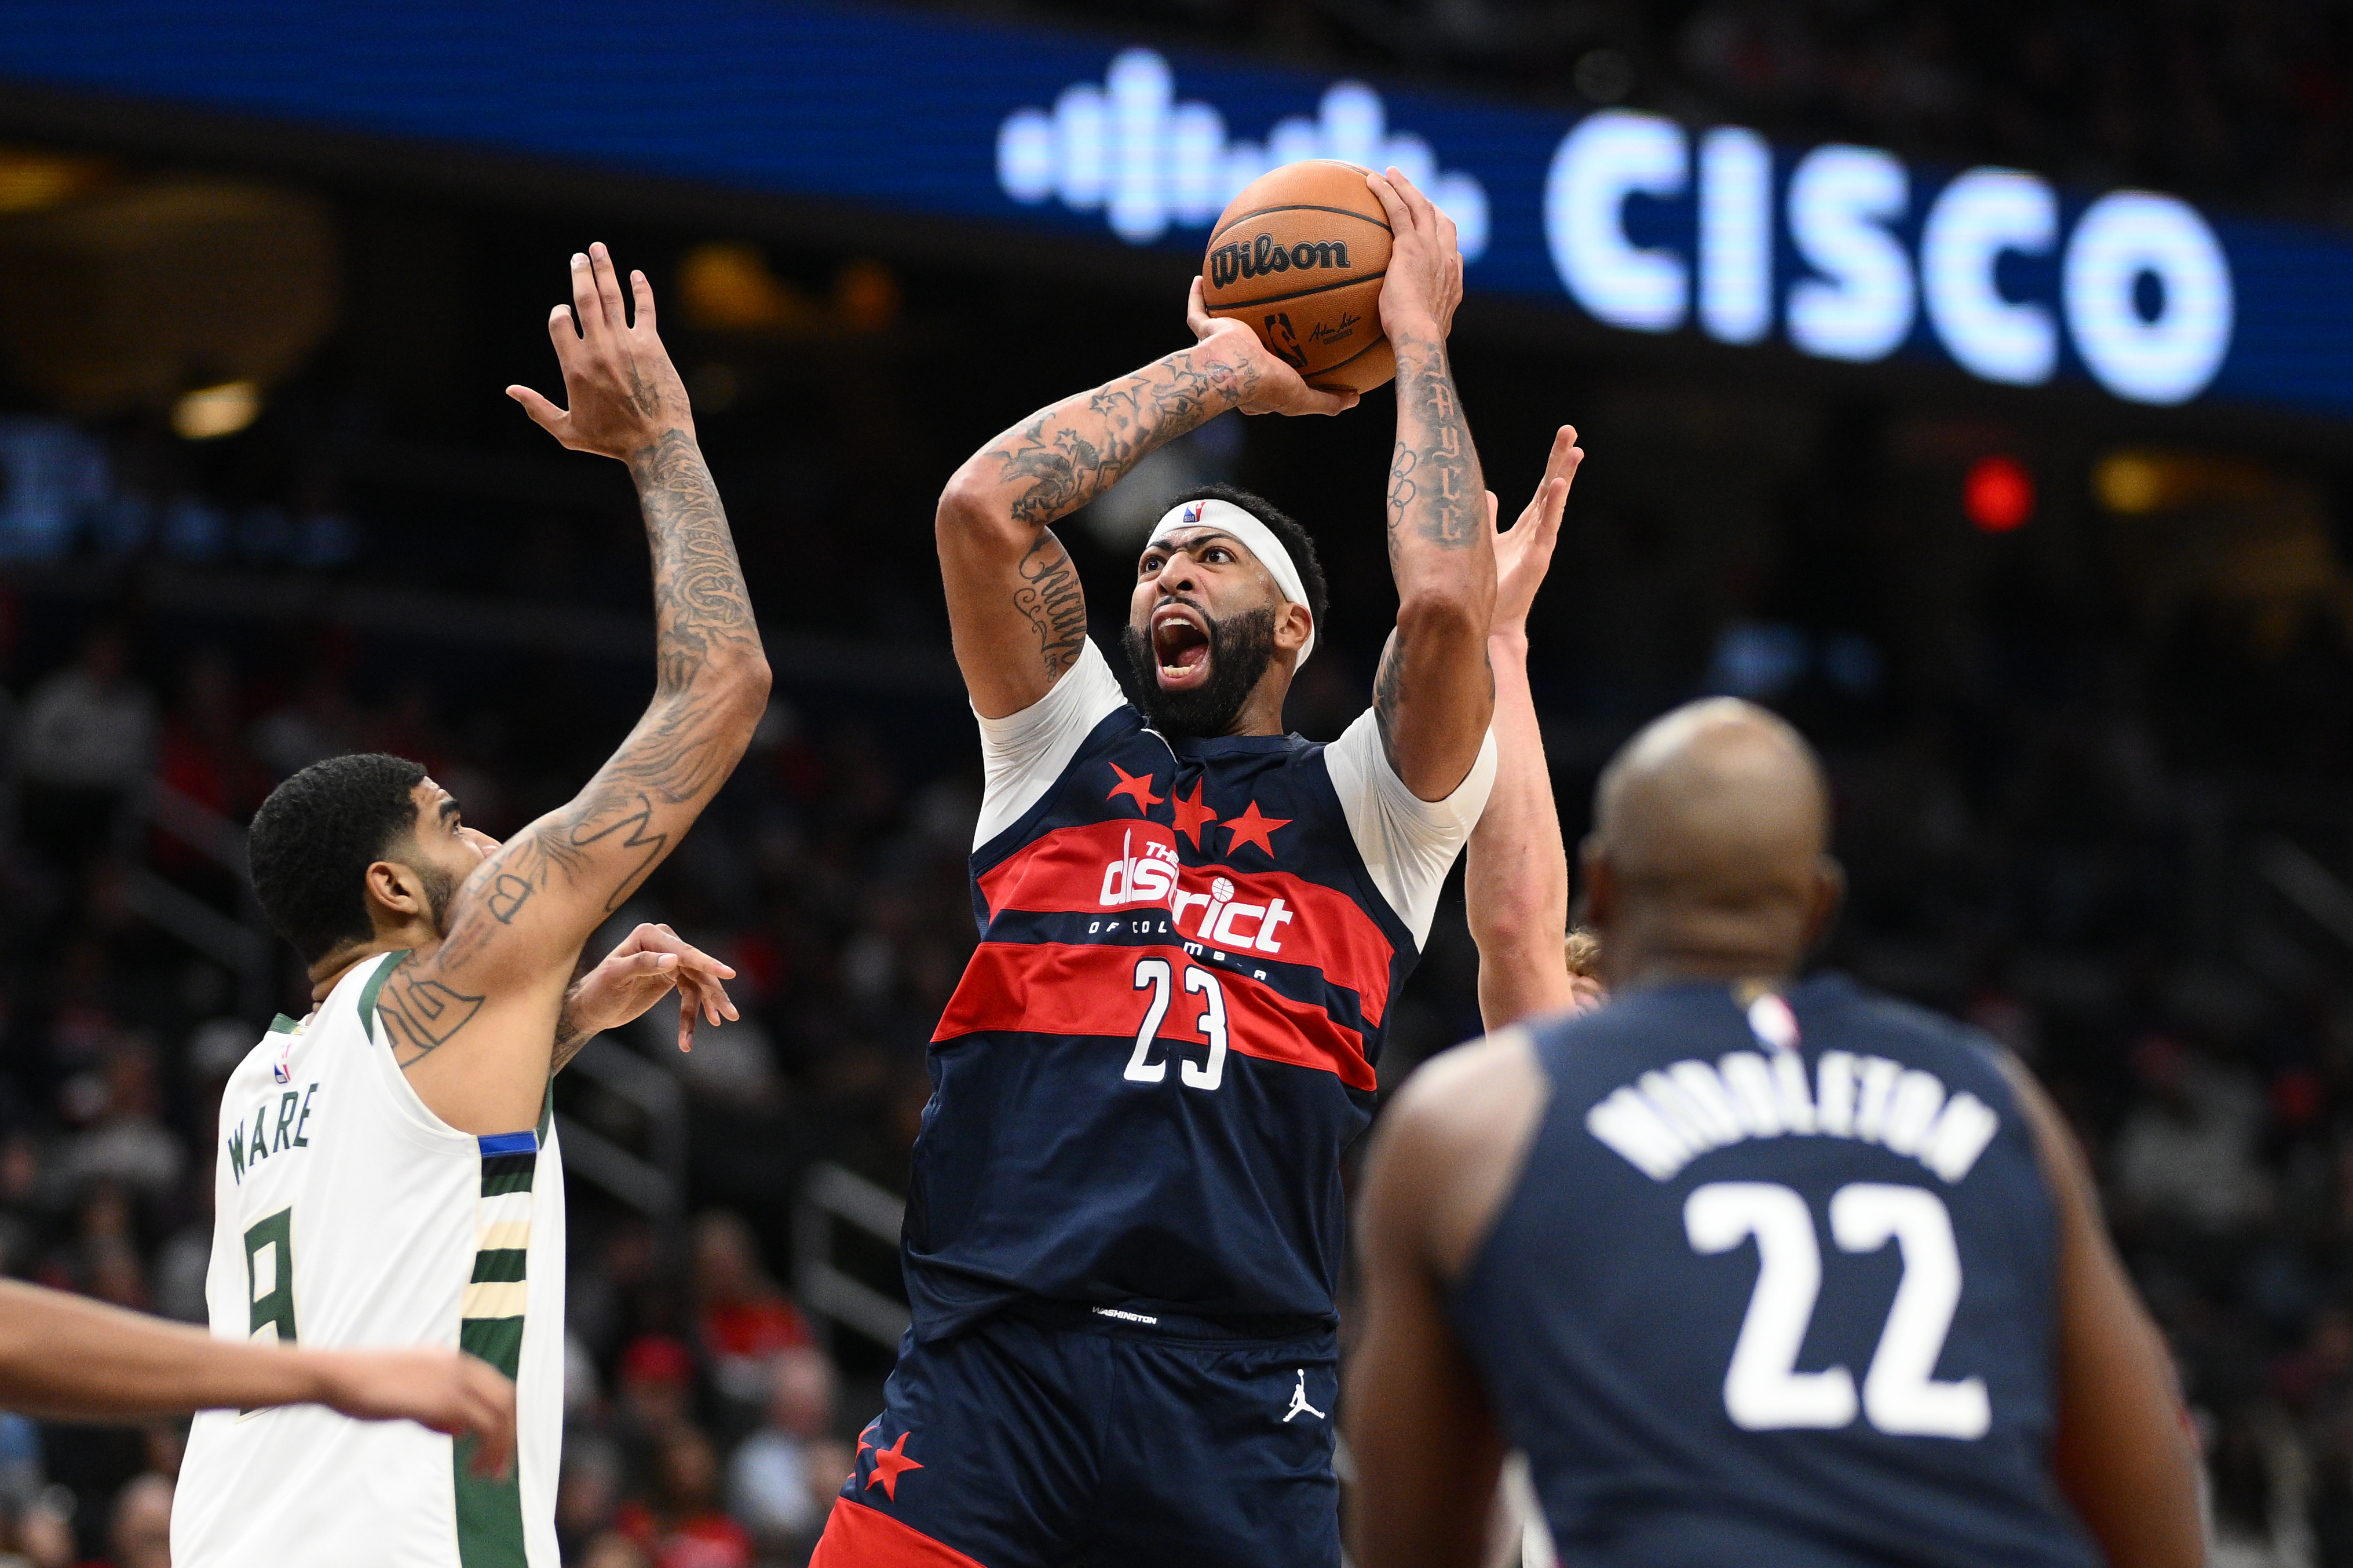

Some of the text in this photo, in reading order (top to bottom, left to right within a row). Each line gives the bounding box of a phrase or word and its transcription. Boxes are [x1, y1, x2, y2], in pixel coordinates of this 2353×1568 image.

[1211, 233, 1350, 289] Wilson
[1544, 108, 2234, 408] CISCO
[1146, 840, 1179, 869] THE
[1088, 920, 1266, 981] OF COLMBA
[1123, 957, 1228, 1091] 23
[228, 1083, 319, 1186] WARE
[1091, 1306, 1157, 1325] WASHINGTON
[1682, 1180, 1993, 1442] 22
